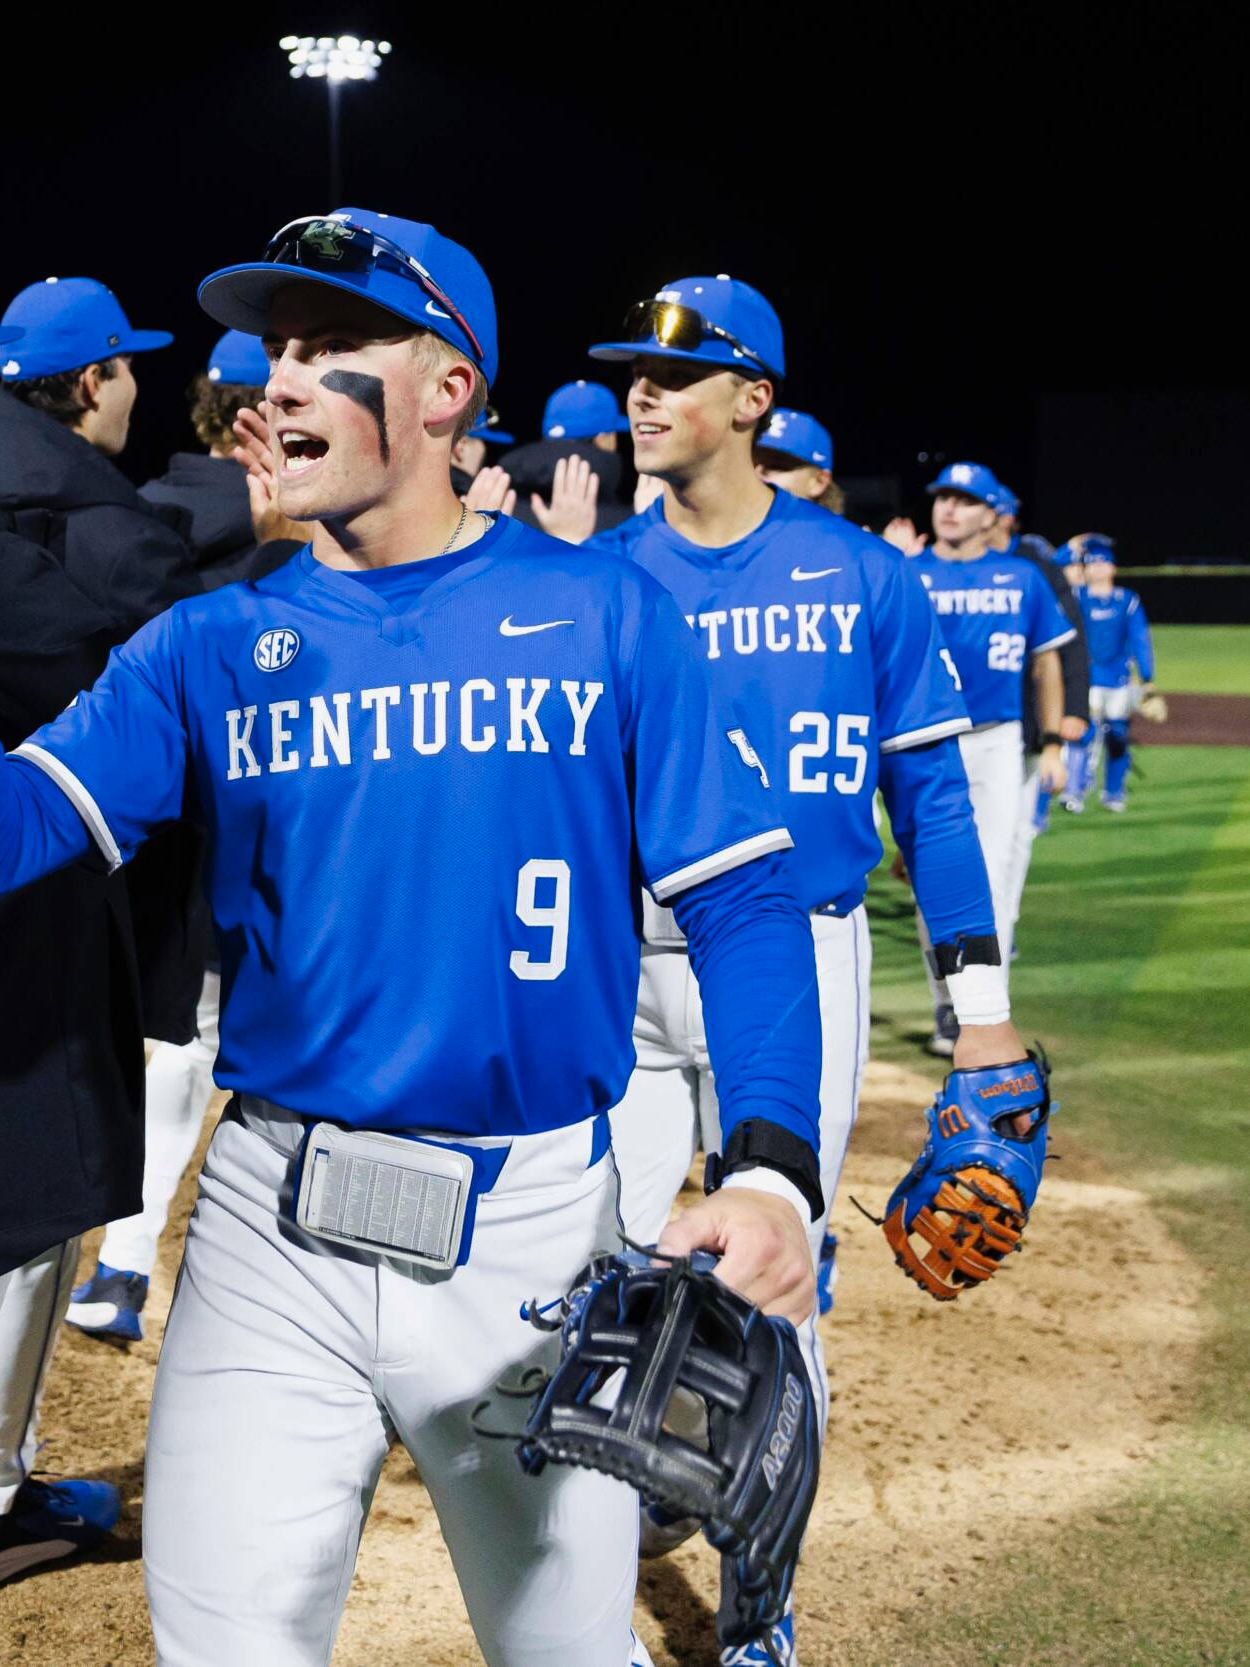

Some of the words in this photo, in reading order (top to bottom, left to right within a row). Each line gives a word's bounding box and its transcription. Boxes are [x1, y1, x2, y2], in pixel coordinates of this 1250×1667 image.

[685, 604, 861, 659] TUCKY
[929, 588, 1022, 615] NTUCKY
[258, 631, 296, 669] SEC
[988, 632, 1026, 672] 22
[226, 678, 604, 780] KENTUCKY
[789, 711, 871, 795] 25
[509, 858, 572, 981] 9
[761, 1372, 803, 1492] A2000
